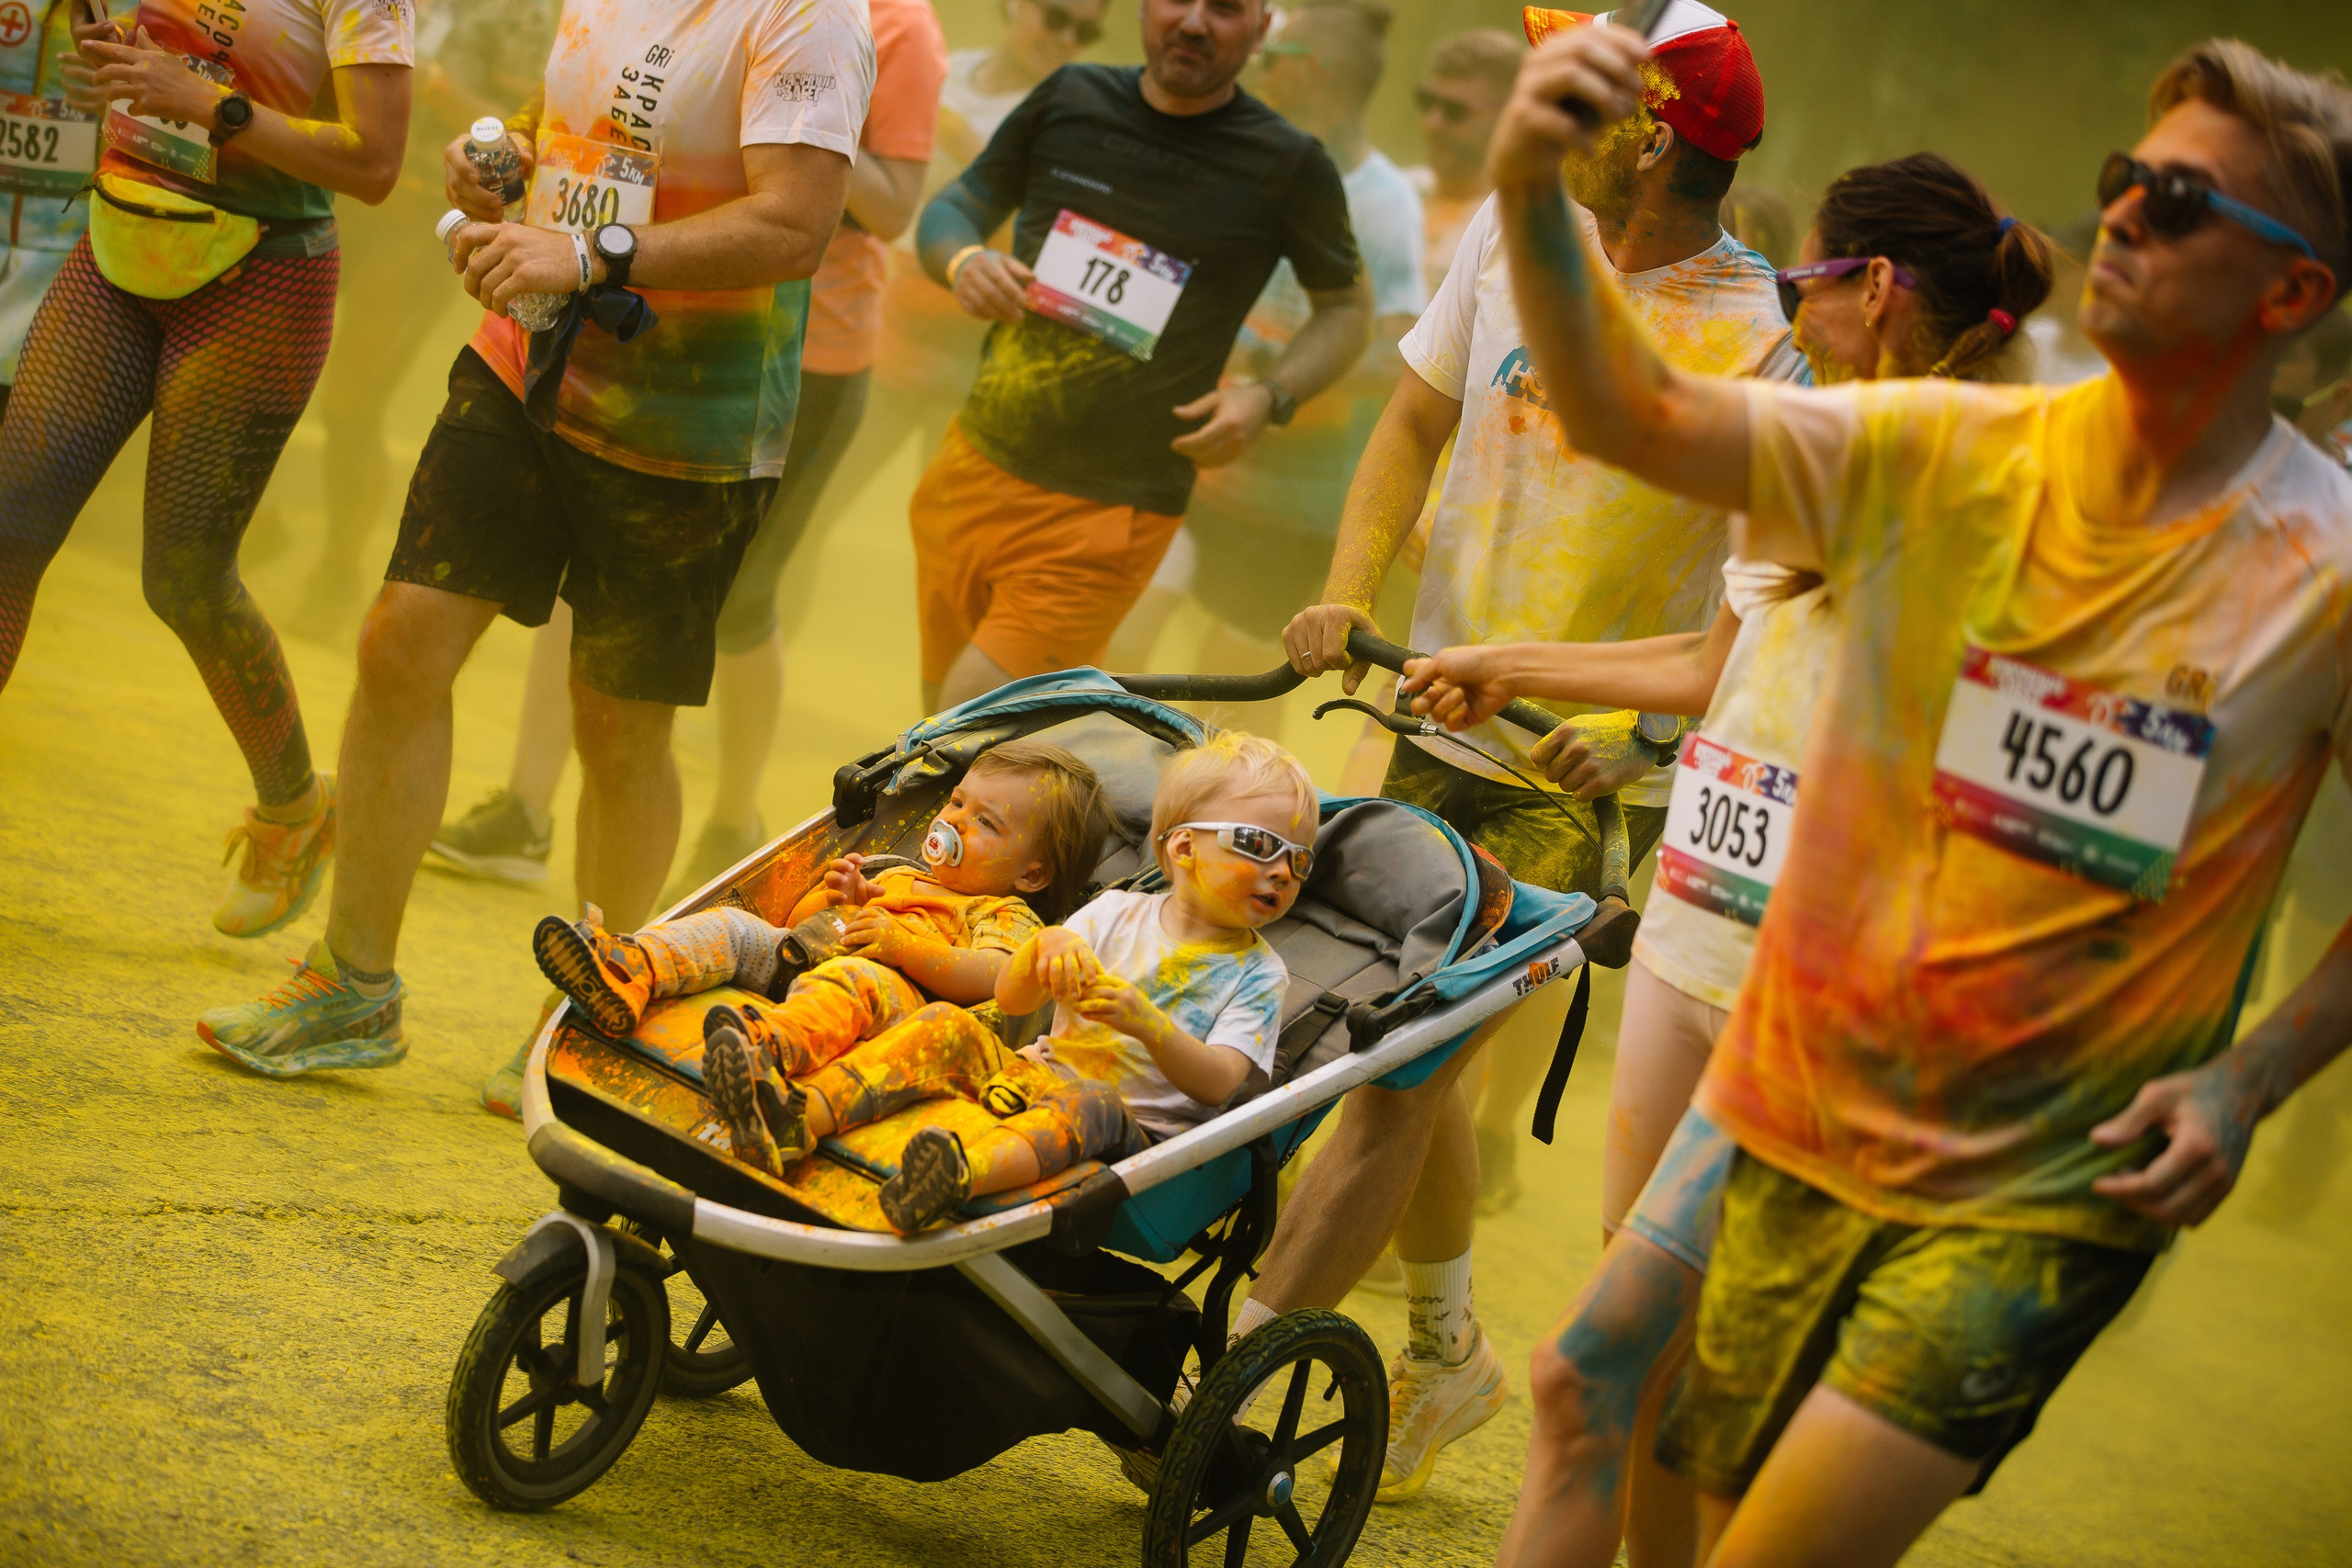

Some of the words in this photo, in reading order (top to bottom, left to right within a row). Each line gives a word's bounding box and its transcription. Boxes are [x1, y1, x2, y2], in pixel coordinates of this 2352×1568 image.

[645, 44, 675, 69] GRi
[783, 85, 824, 102] ЗАБЕГ
[551, 177, 620, 229] 3680
[1079, 257, 1131, 306] 178
[1999, 708, 2135, 817] 4560
[1690, 786, 1770, 868] 3053
[1512, 956, 1561, 998] THULE
